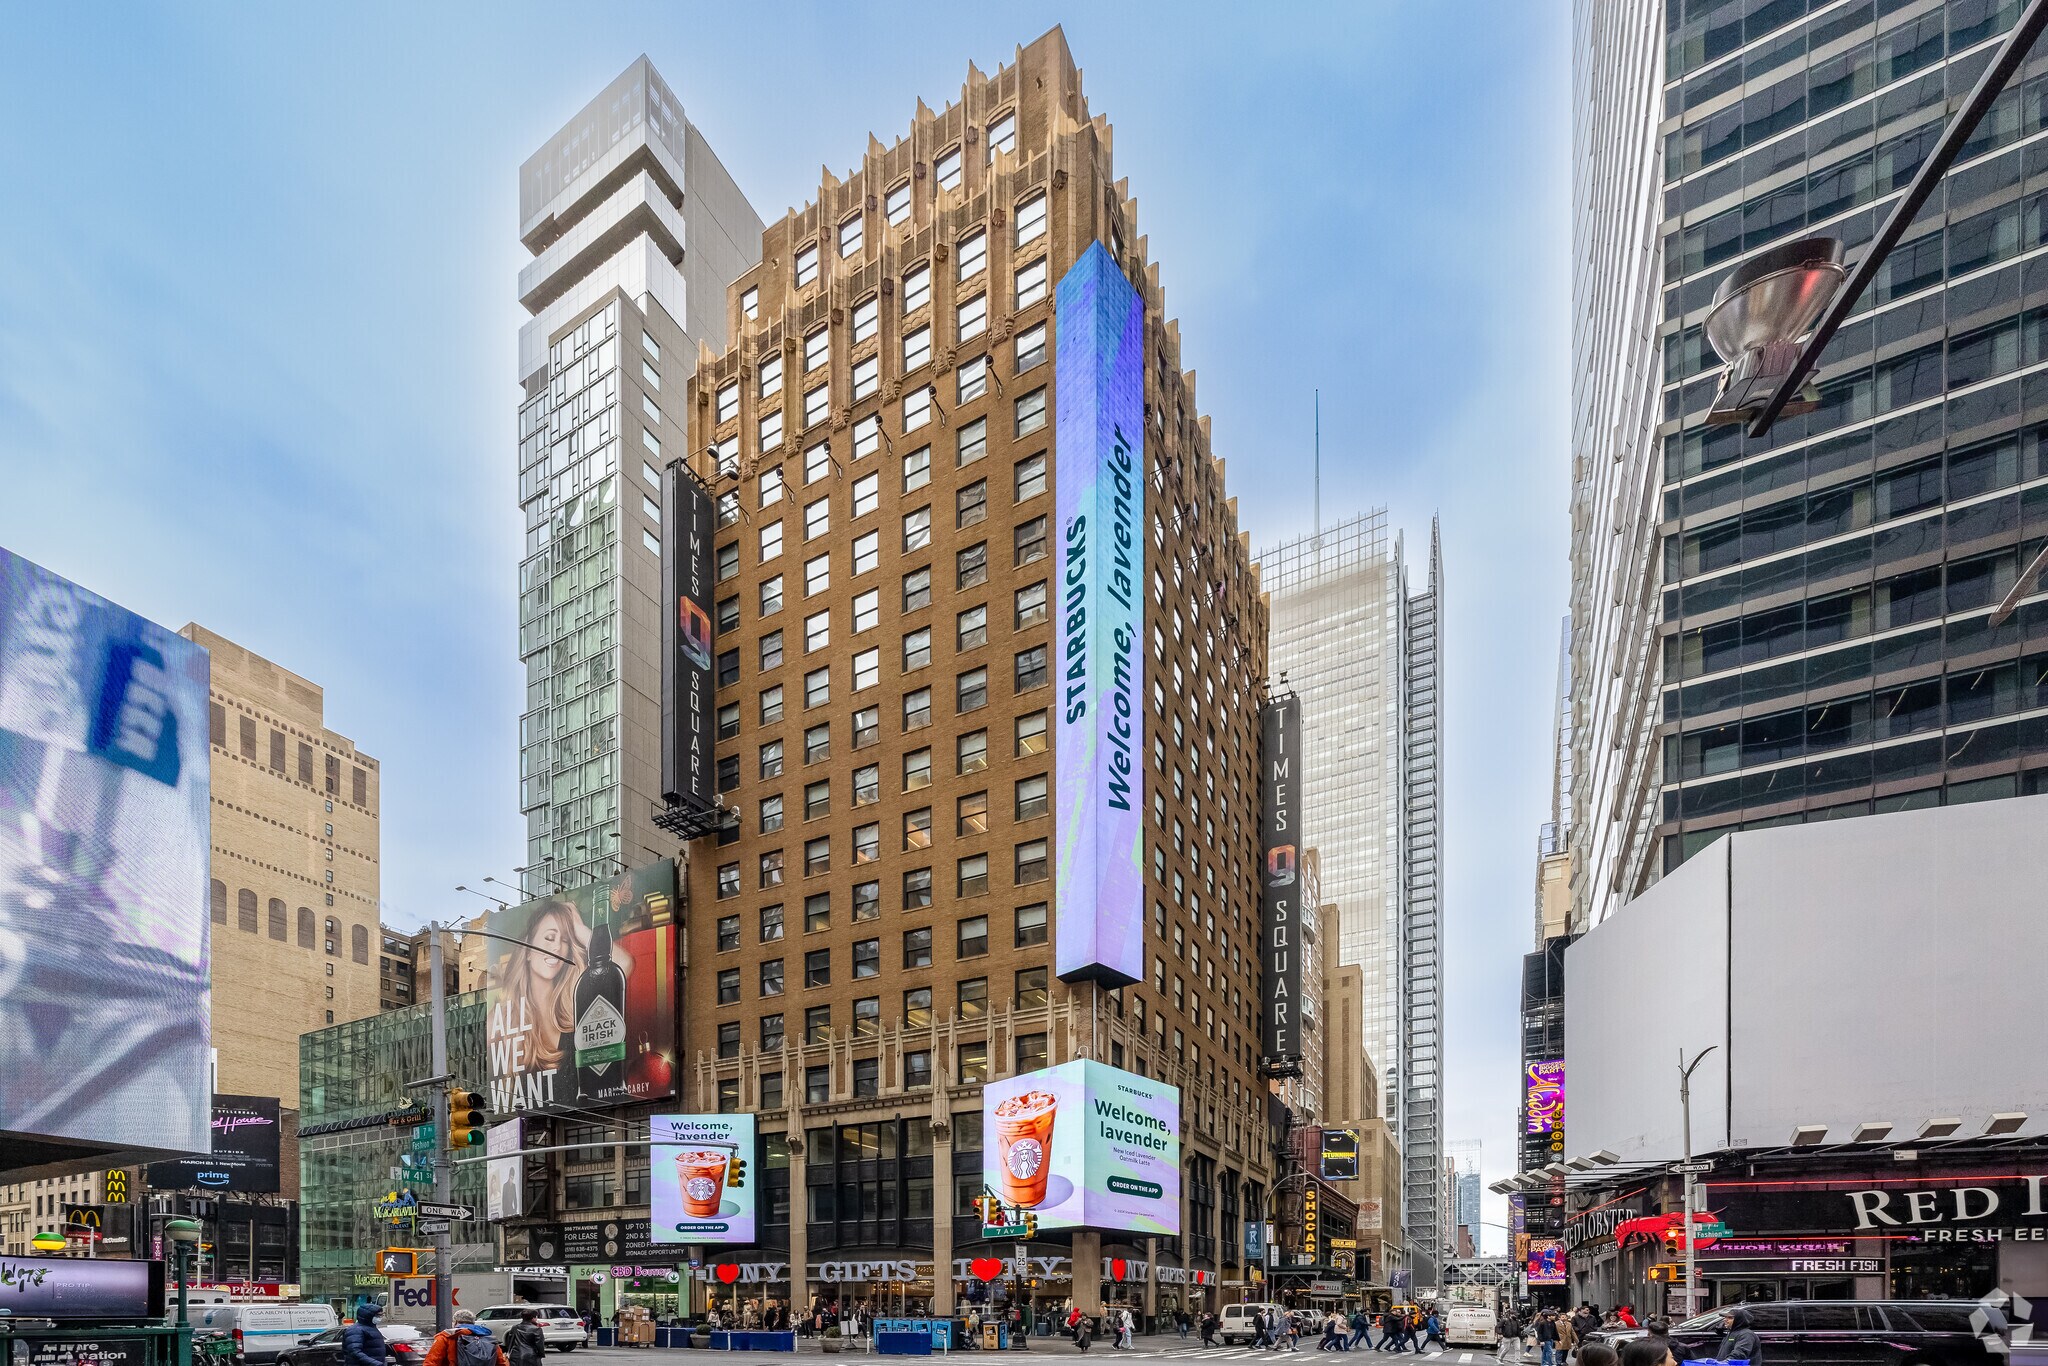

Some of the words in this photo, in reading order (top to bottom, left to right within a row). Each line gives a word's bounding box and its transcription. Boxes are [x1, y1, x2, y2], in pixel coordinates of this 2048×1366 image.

[1108, 423, 1133, 609] lavender
[689, 490, 700, 597] TIMES
[1066, 514, 1087, 726] STARBUCKS
[1108, 620, 1137, 812] Welcome,
[689, 670, 700, 797] SQUARE
[1273, 707, 1289, 832] TIMES
[1273, 900, 1289, 1052] SQUARE
[491, 996, 532, 1039] ALL
[582, 1020, 617, 1034] BLACK
[585, 1029, 614, 1042] IRISH
[491, 1036, 526, 1077] WE
[490, 1069, 559, 1114] WANT
[627, 1082, 650, 1094] CAREY
[1117, 1085, 1153, 1099] STARBUCKS
[406, 1115, 421, 1123] Grill
[1094, 1098, 1171, 1136] Welcome,
[422, 1128, 427, 1137] 7
[670, 1122, 733, 1131] Welcome,
[675, 1132, 730, 1140] lavender
[1100, 1121, 1168, 1151] lavender
[412, 1140, 430, 1150] Fashion
[1124, 1149, 1135, 1157] Iced
[1136, 1151, 1156, 1161] Lavender
[1138, 1158, 1151, 1166] Latte
[197, 1171, 230, 1180] prime
[402, 1170, 410, 1179] W
[413, 1171, 423, 1181] 41
[1112, 1181, 1130, 1190] ORDER
[373, 1205, 418, 1218] MARGARITAVILL
[450, 1209, 467, 1217] WAY
[1845, 1187, 1999, 1230] RED
[578, 1232, 598, 1240] LEASE
[1563, 1222, 1581, 1254] RED
[1697, 1230, 1723, 1238] Fashion
[1924, 1229, 2003, 1242] FRESH
[2014, 1228, 2048, 1241] EE
[625, 1241, 646, 1249] ZONED
[648, 1248, 685, 1256] OPPORTUNITY
[1002, 1257, 1065, 1280] NY
[1017, 1257, 1026, 1266] 25
[1791, 1260, 1846, 1271] FRESH
[1850, 1260, 1878, 1271] FISH
[611, 1266, 633, 1277] CBD
[705, 1264, 717, 1283] I
[738, 1263, 786, 1283] NY
[819, 1260, 917, 1282] GIFTS
[1102, 1257, 1112, 1280] I
[1126, 1260, 1149, 1283] NY
[1155, 1266, 1186, 1284] GIFTS
[1204, 1271, 1216, 1286] NY
[232, 1285, 266, 1295] PIZZA
